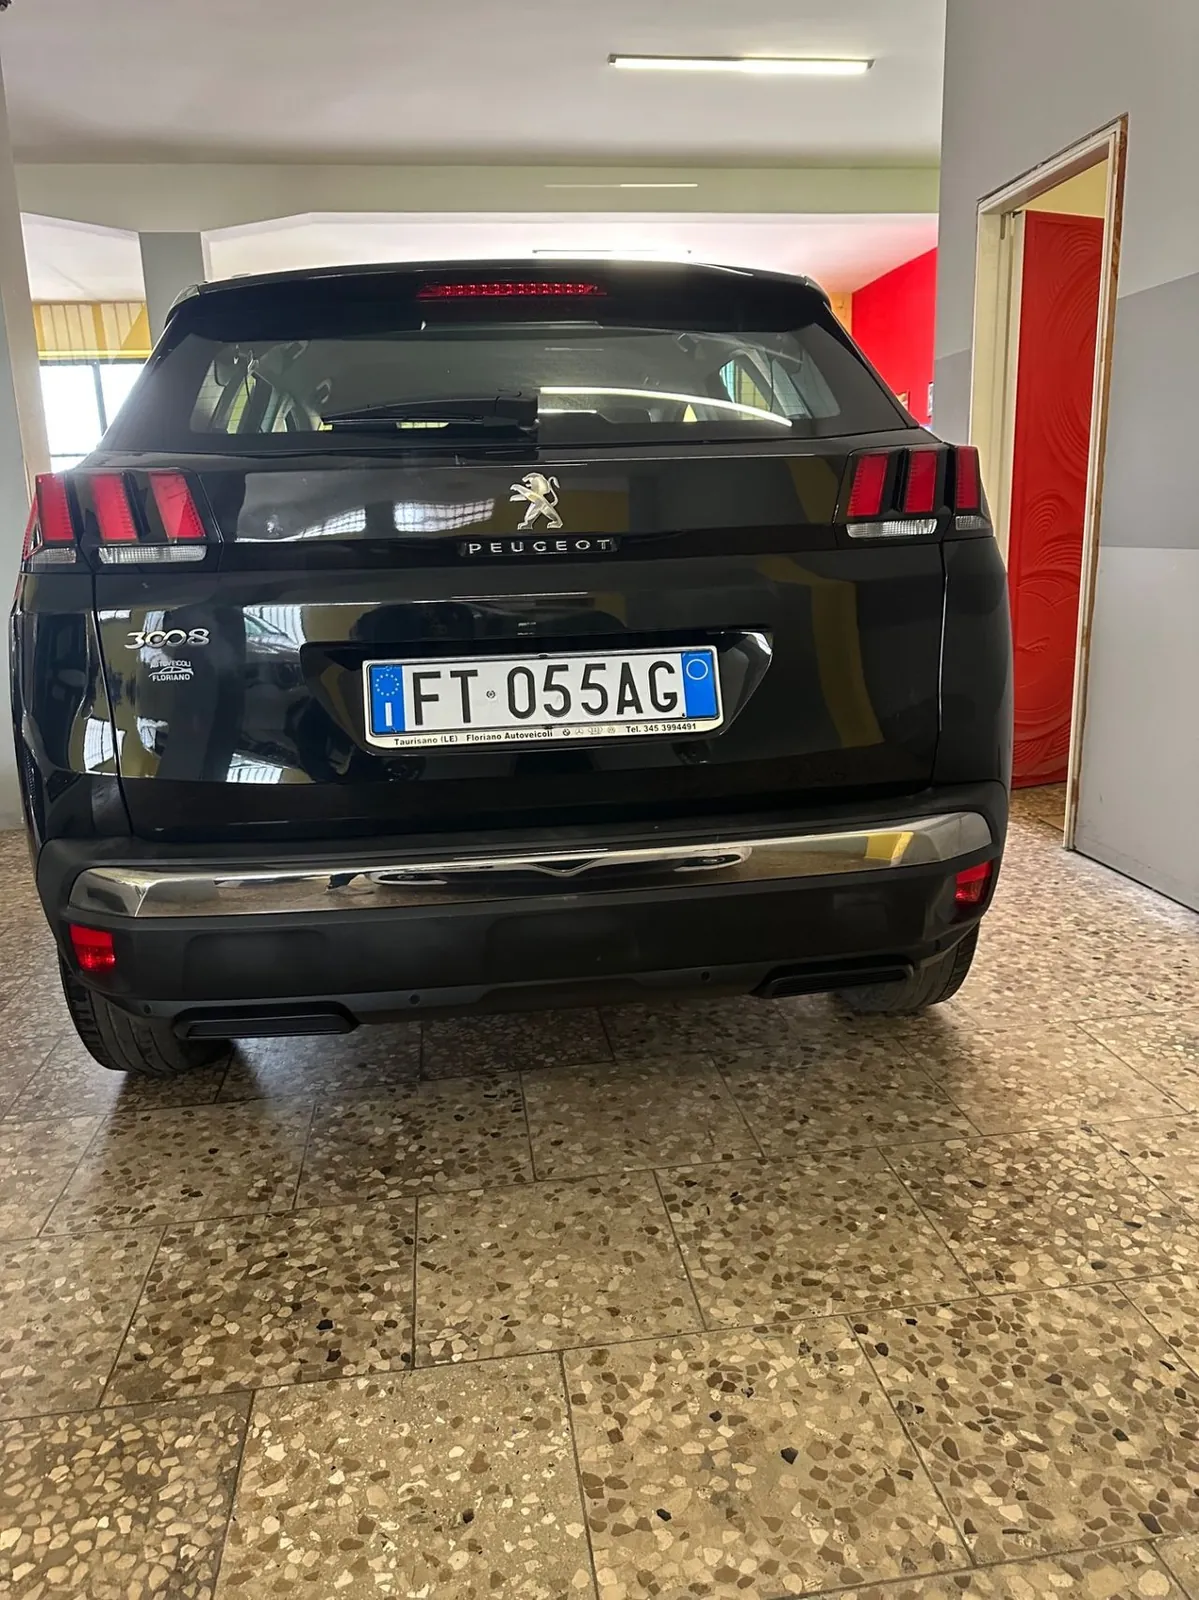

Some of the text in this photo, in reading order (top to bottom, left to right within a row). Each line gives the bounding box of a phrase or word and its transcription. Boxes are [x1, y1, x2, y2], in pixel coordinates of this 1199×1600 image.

[468, 539, 610, 554] PEUGEOT
[124, 628, 210, 649] 3008
[152, 673, 191, 682] FLORIANO
[411, 660, 679, 727] FT 055AG
[625, 722, 697, 734] Tel. 345 3994491
[394, 729, 553, 746] Taurisano (LE) Floriano Autoveicoli
